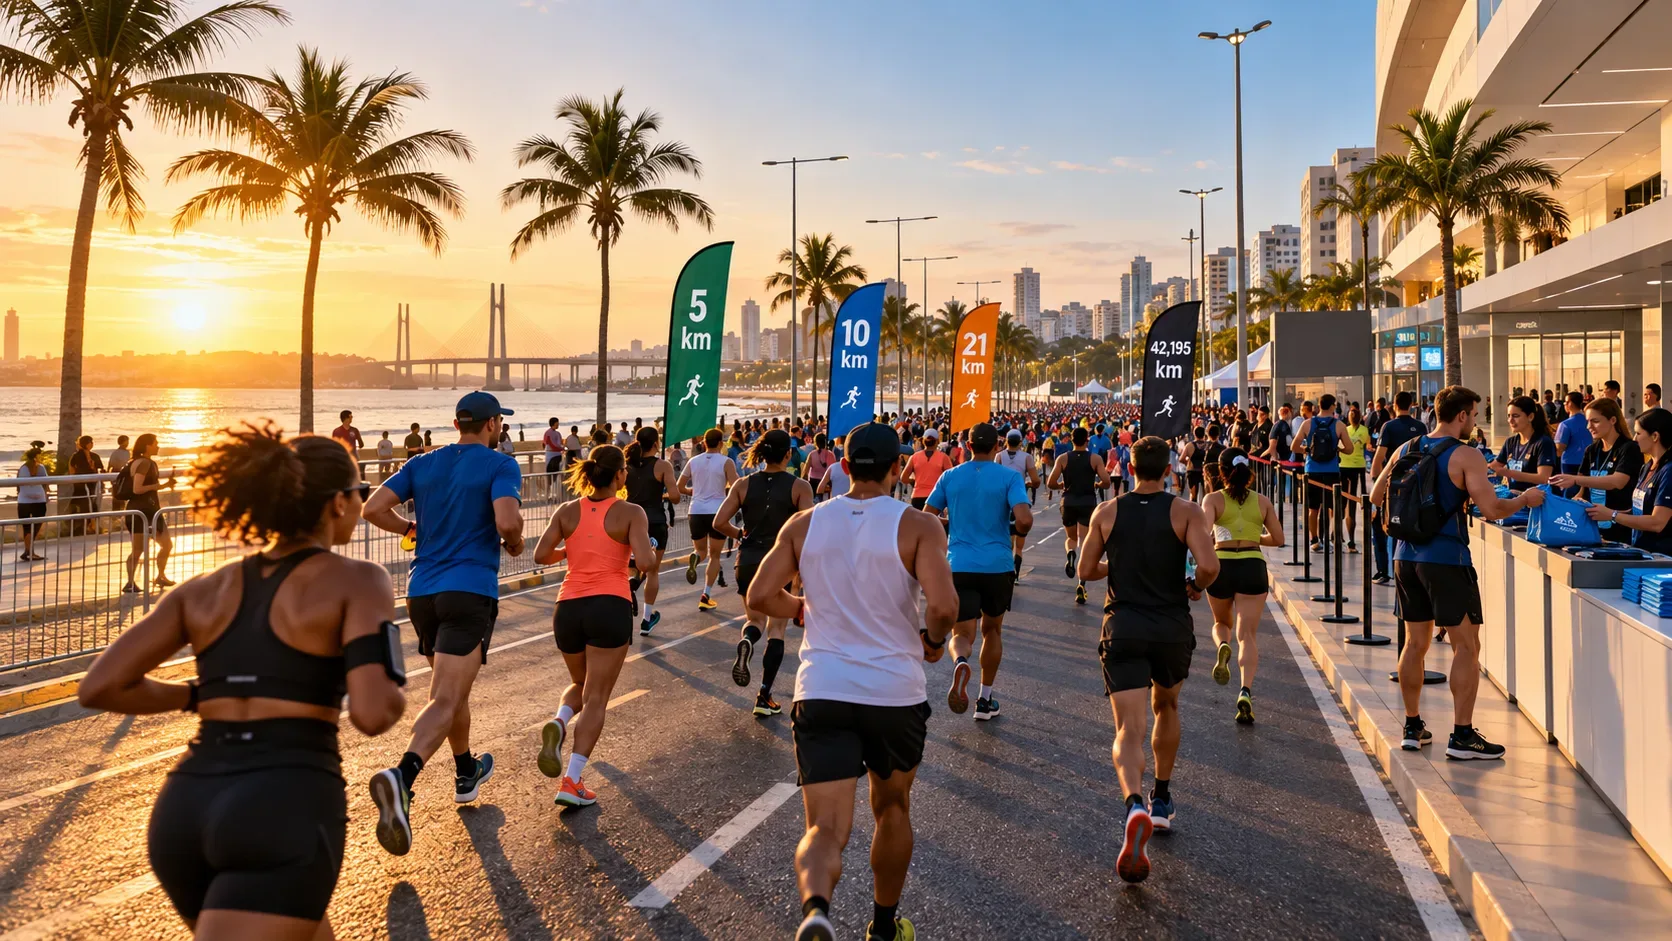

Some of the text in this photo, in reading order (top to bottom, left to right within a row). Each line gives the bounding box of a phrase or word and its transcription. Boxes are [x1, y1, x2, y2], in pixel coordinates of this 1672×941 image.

[689, 289, 707, 323] 5
[681, 326, 711, 350] km
[841, 319, 870, 347] 10
[962, 332, 987, 356] 21
[1150, 341, 1191, 357] 42,195
[841, 350, 868, 369] km
[961, 358, 985, 375] km
[1155, 360, 1182, 378] km
